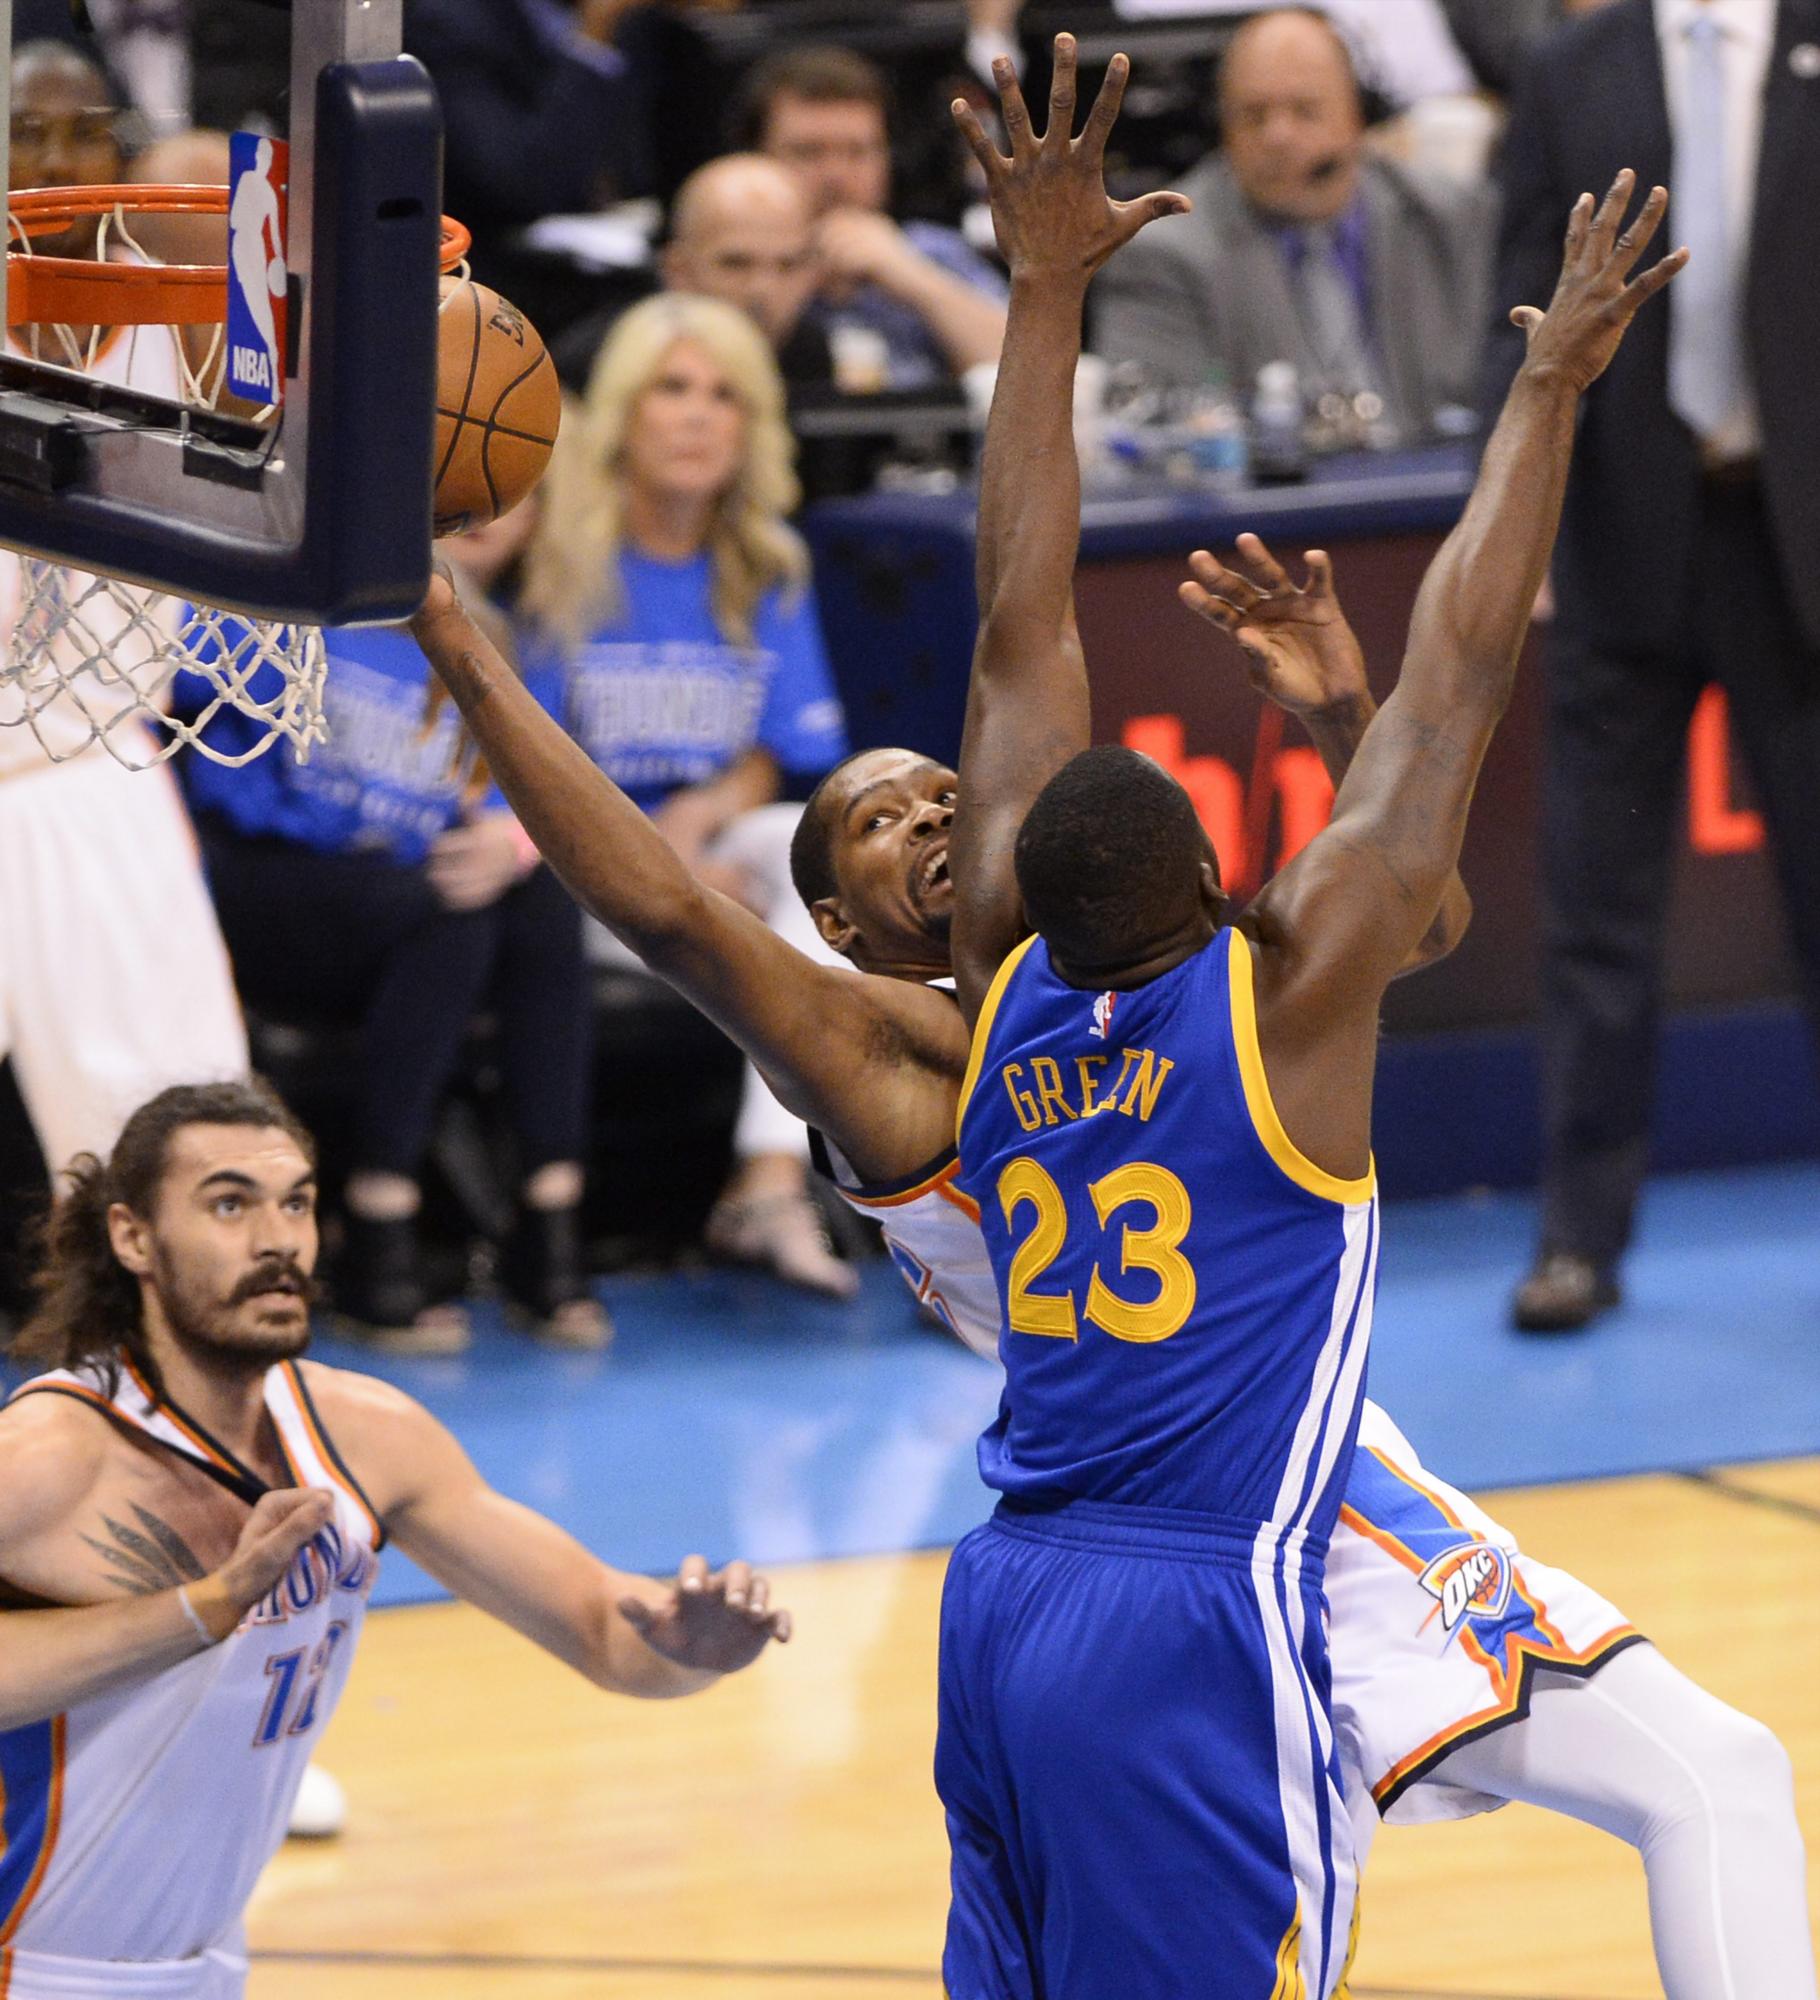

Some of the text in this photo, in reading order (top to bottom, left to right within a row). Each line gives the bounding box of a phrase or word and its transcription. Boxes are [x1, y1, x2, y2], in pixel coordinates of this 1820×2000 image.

[233, 345, 271, 388] NBA
[996, 1156, 1197, 1344] 23
[1442, 1547, 1494, 1632] OKC
